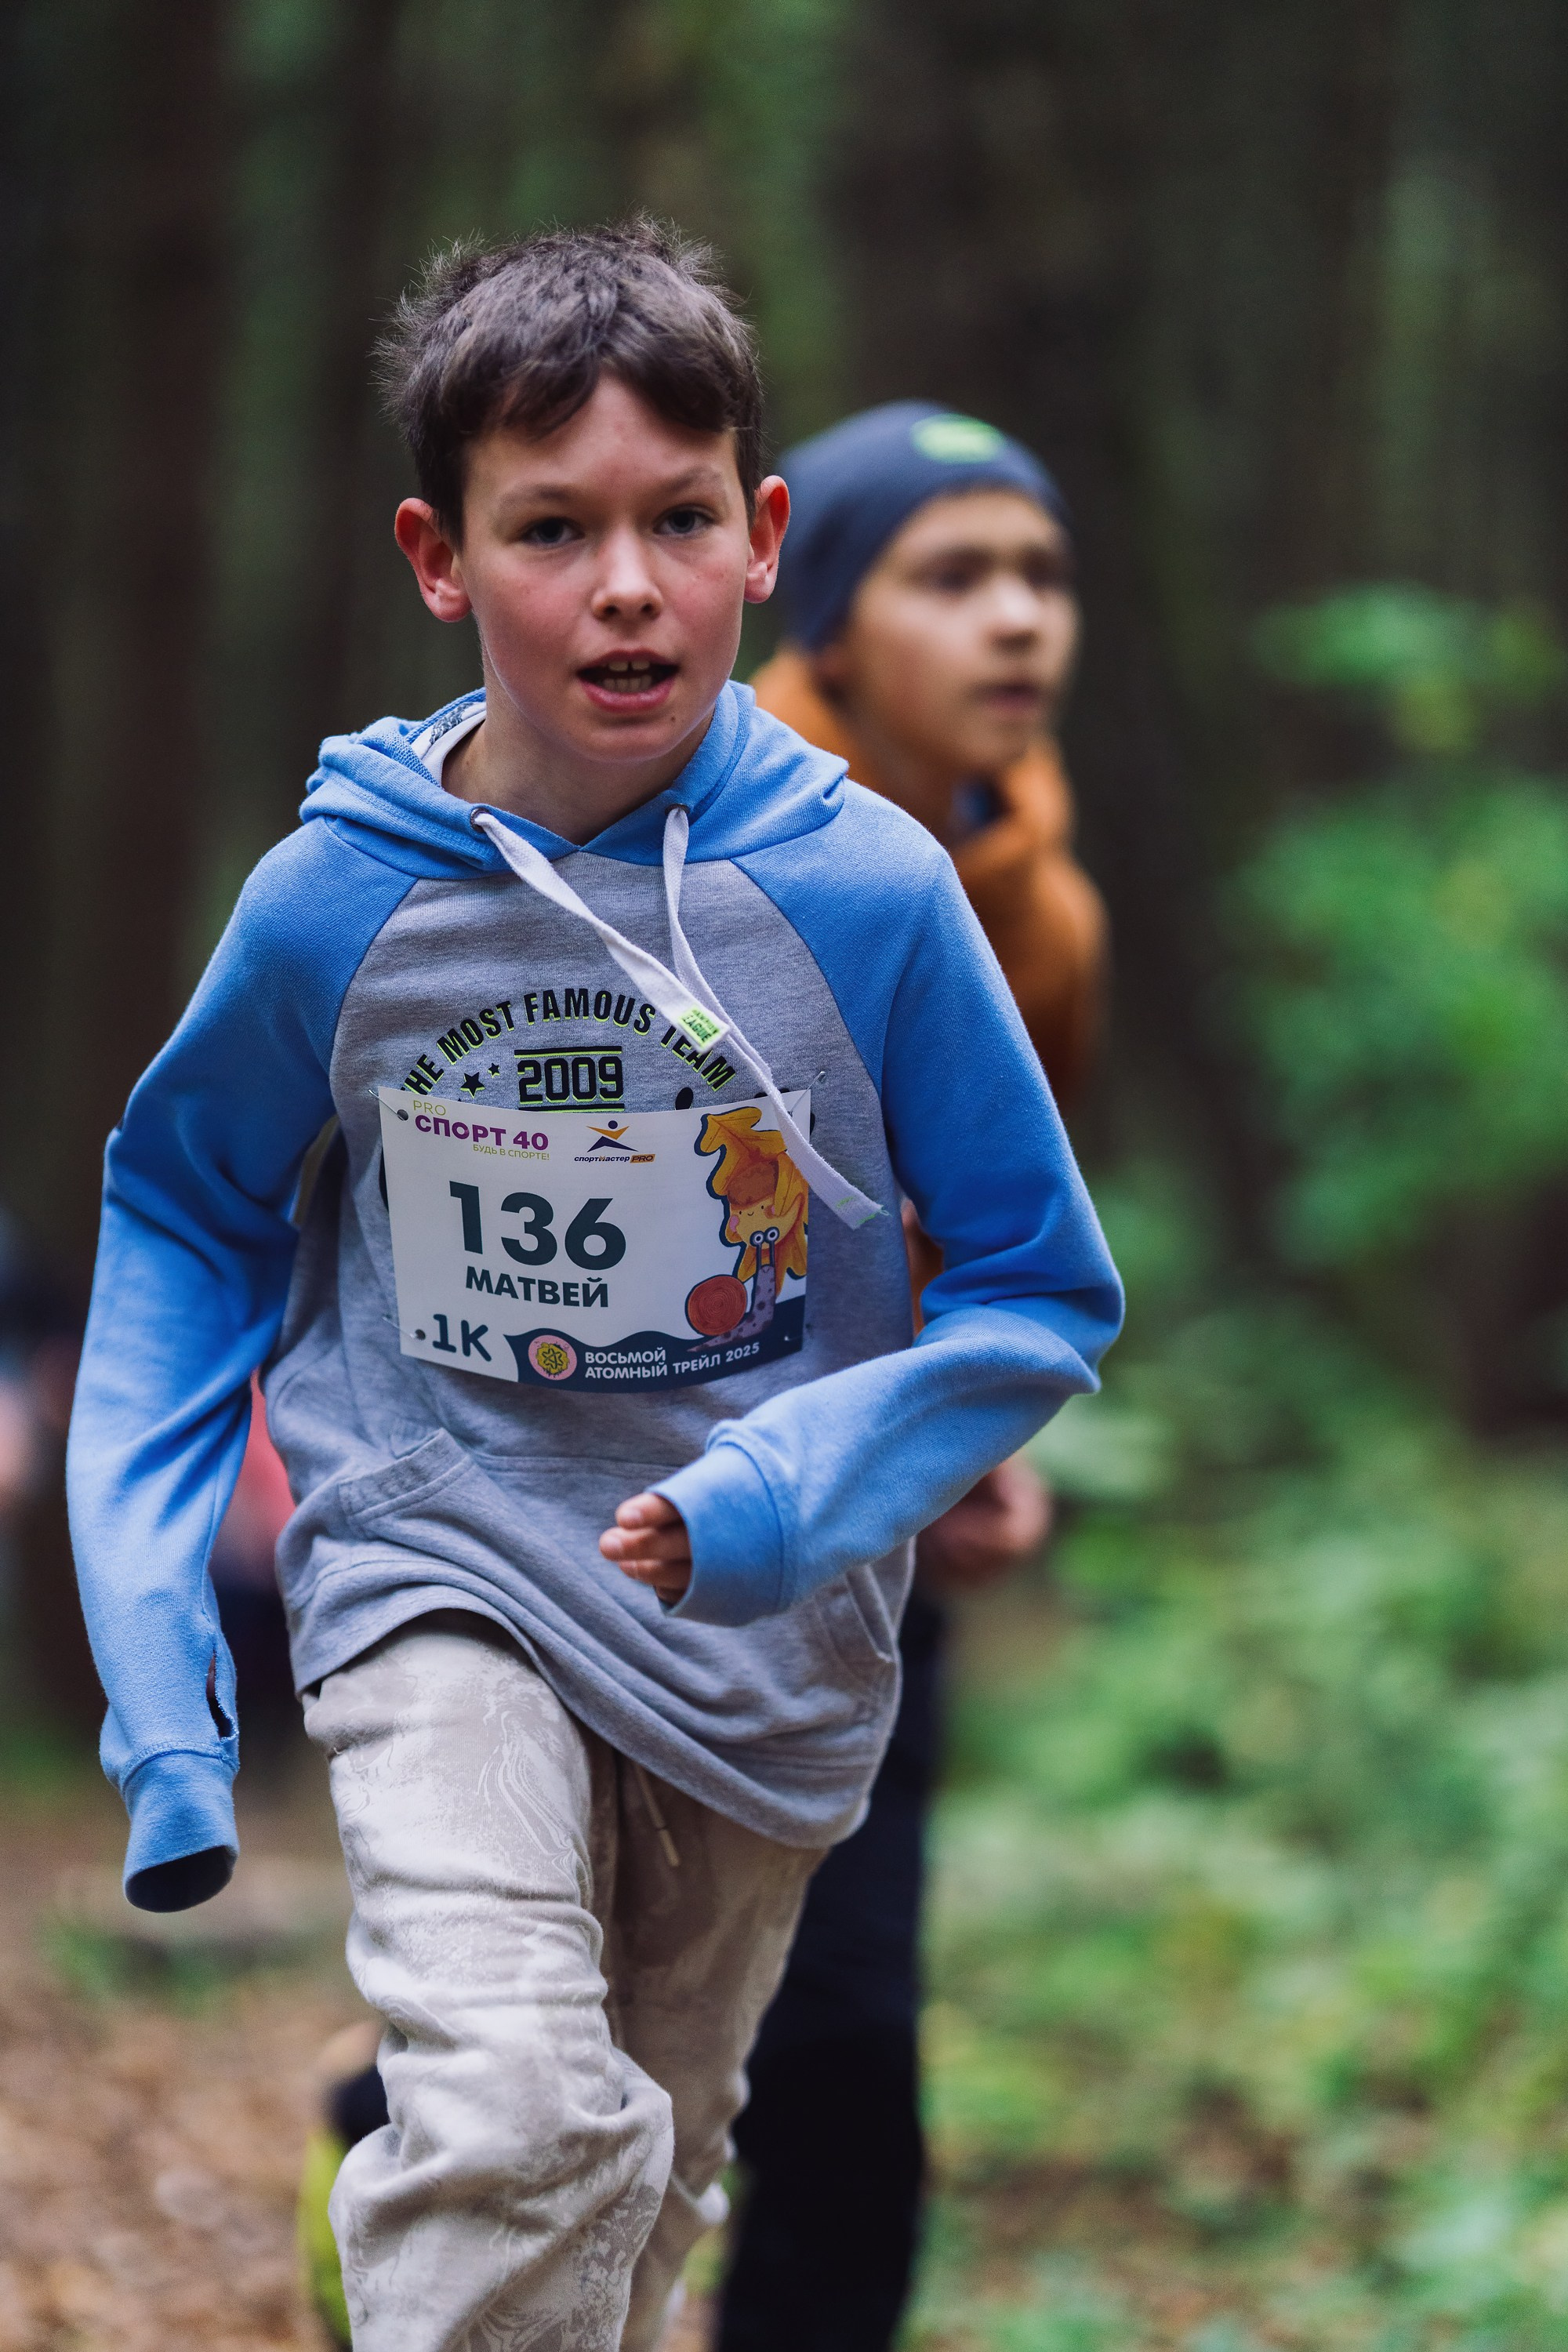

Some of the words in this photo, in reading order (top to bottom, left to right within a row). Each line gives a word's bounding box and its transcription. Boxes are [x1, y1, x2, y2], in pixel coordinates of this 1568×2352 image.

[401, 1054, 445, 1095] HE
[436, 1000, 514, 1065] MOST
[524, 988, 655, 1036] FAMOUS
[517, 1056, 624, 1105] 2009
[413, 1100, 446, 1116] PRO
[415, 1115, 506, 1146] СПОРТ
[513, 1131, 549, 1151] 40
[473, 1144, 498, 1155] БУДЬ
[508, 1149, 550, 1160] СПОРТЕ!
[449, 1181, 626, 1271] 136
[466, 1265, 608, 1308] МАТВЕЙ
[585, 1347, 666, 1364] ВОСЬМОЙ
[585, 1362, 668, 1379] АТОМНЫЙ
[673, 1354, 720, 1374] ТРЕЙЛ
[726, 1341, 760, 1363] 2025
